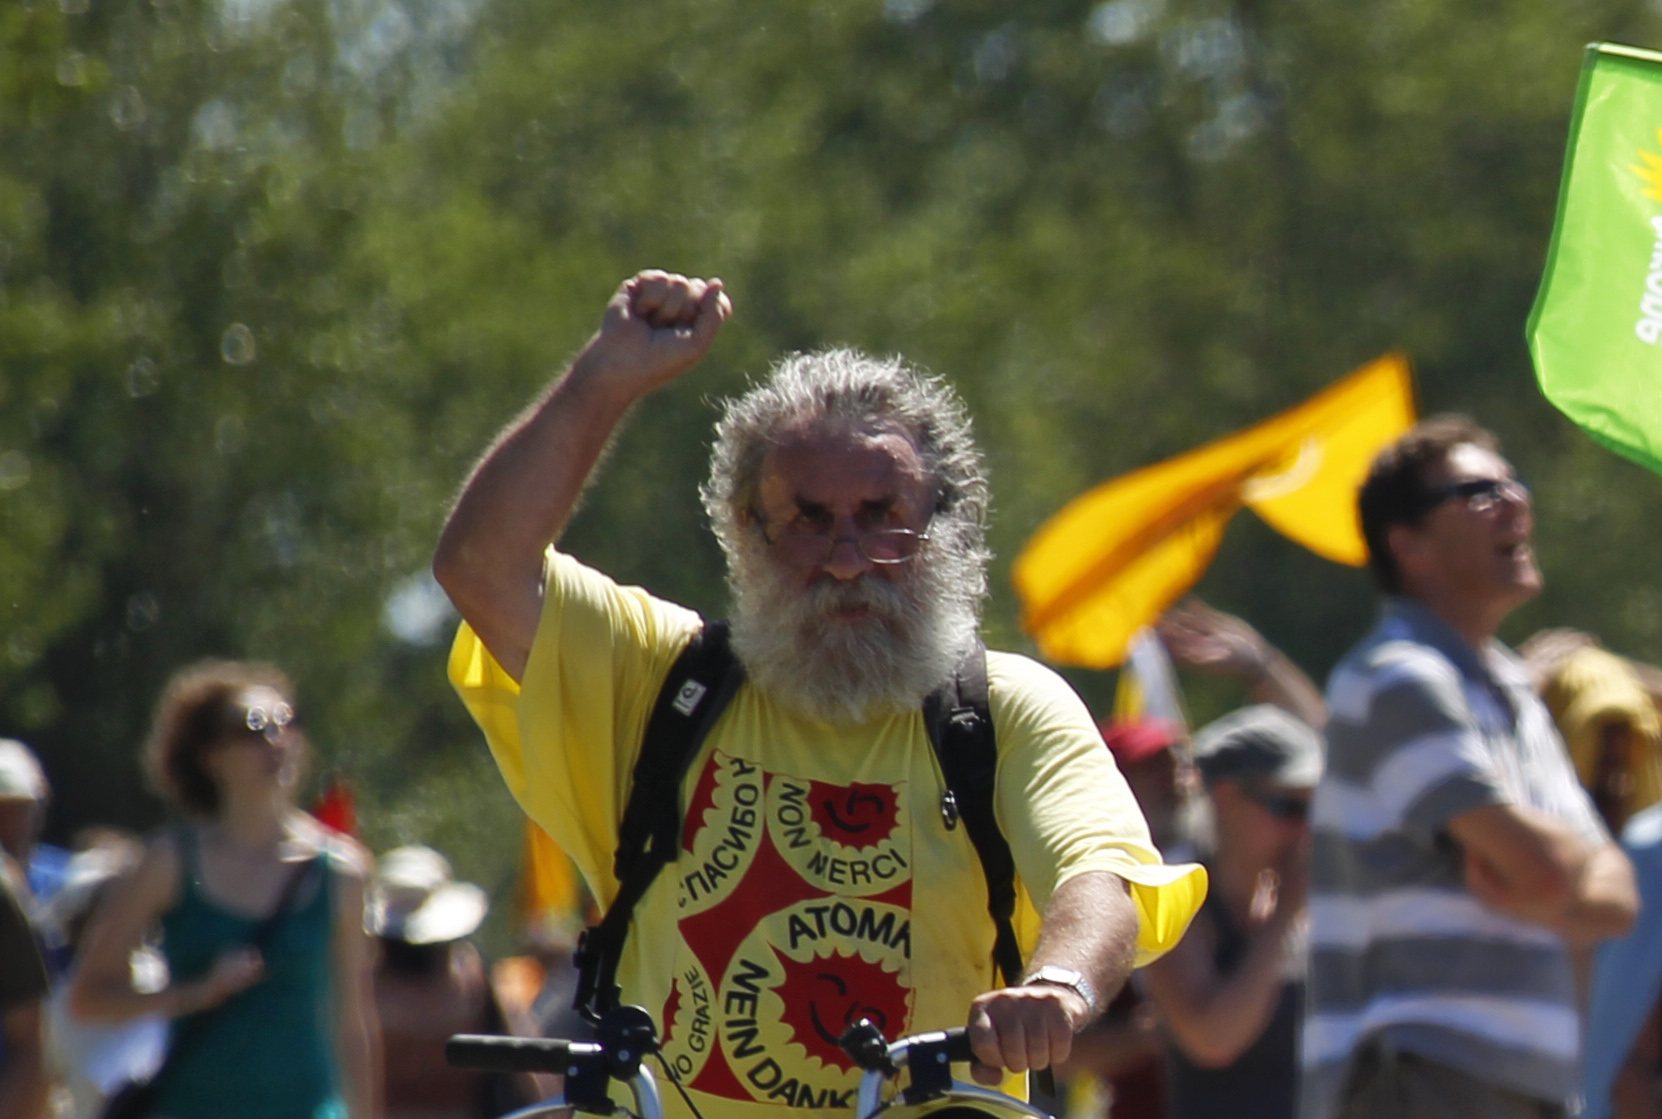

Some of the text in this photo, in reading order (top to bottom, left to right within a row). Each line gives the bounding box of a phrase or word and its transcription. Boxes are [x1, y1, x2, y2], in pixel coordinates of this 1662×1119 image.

[777, 782, 812, 849] NON
[685, 965, 710, 1053] GRAZIE
[725, 958, 770, 1060] NEIN
